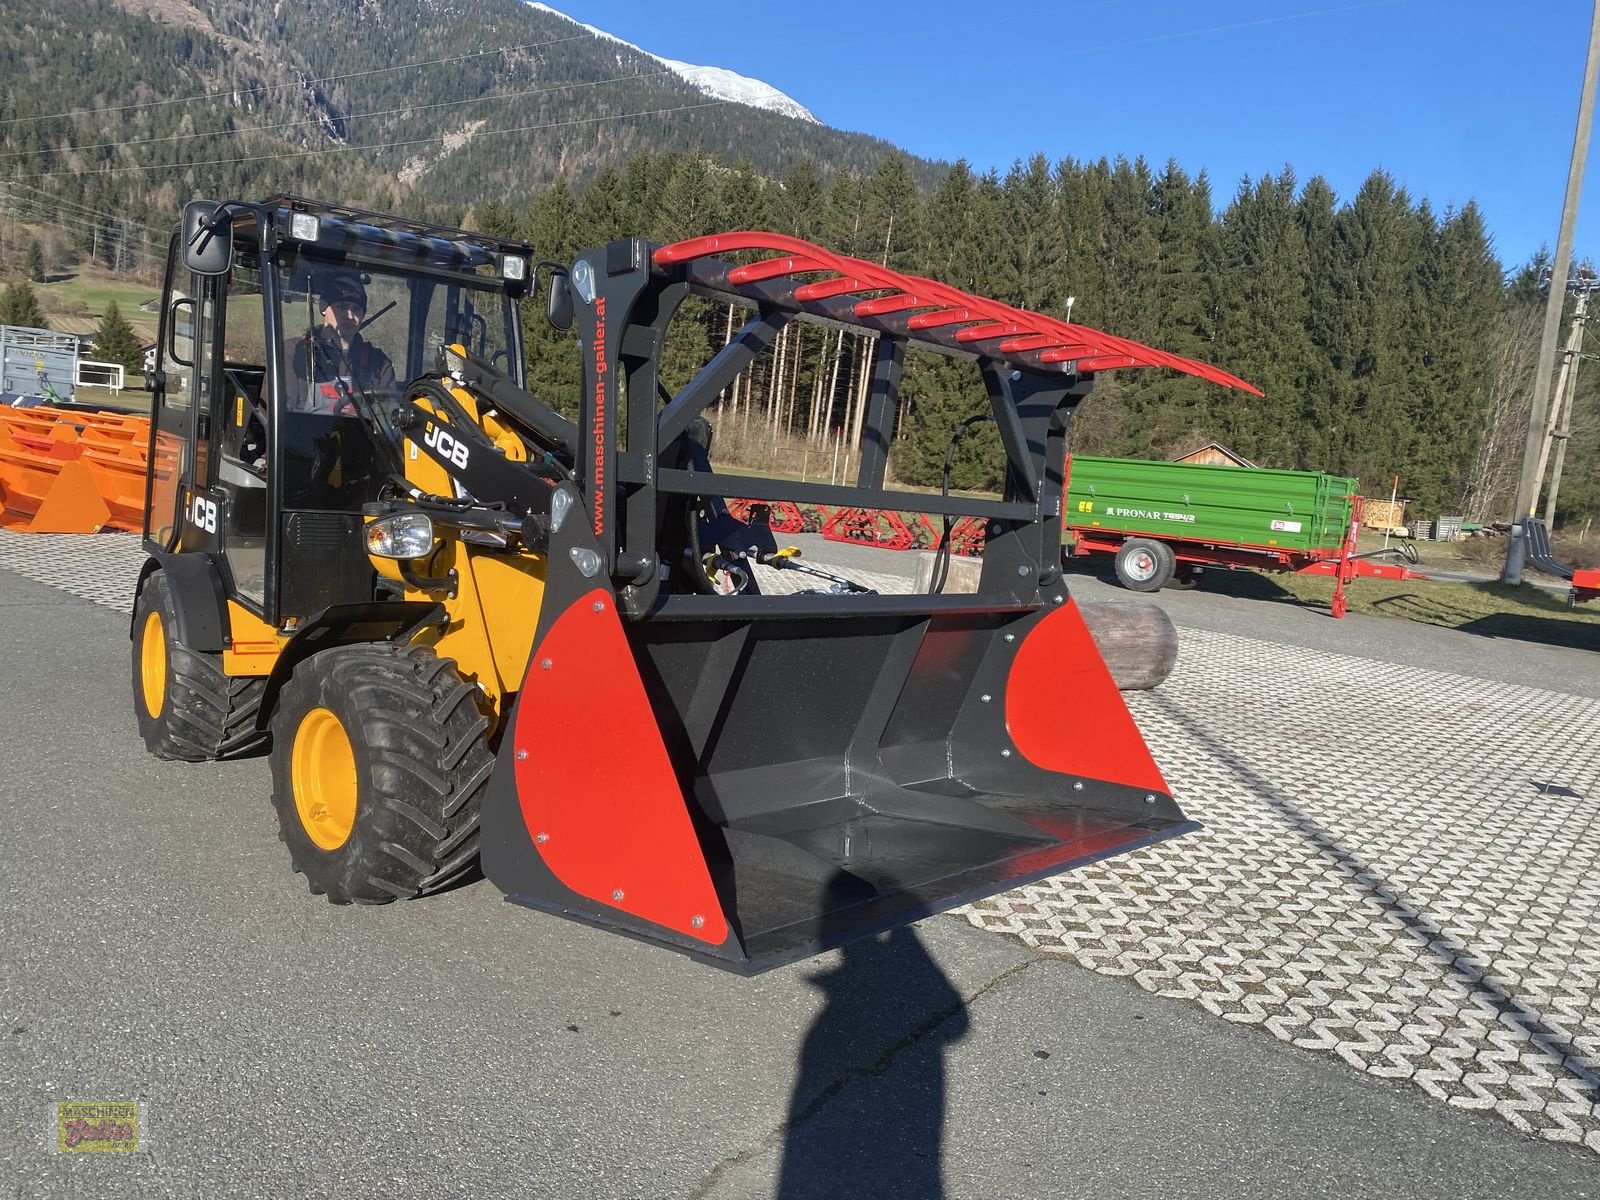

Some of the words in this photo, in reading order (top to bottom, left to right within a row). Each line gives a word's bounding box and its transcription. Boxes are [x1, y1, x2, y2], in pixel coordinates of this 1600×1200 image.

[593, 296, 606, 537] www.maschinen-gailer.at
[424, 426, 469, 470] JCB
[185, 496, 217, 535] JCB
[1116, 507, 1161, 520] PRONAR
